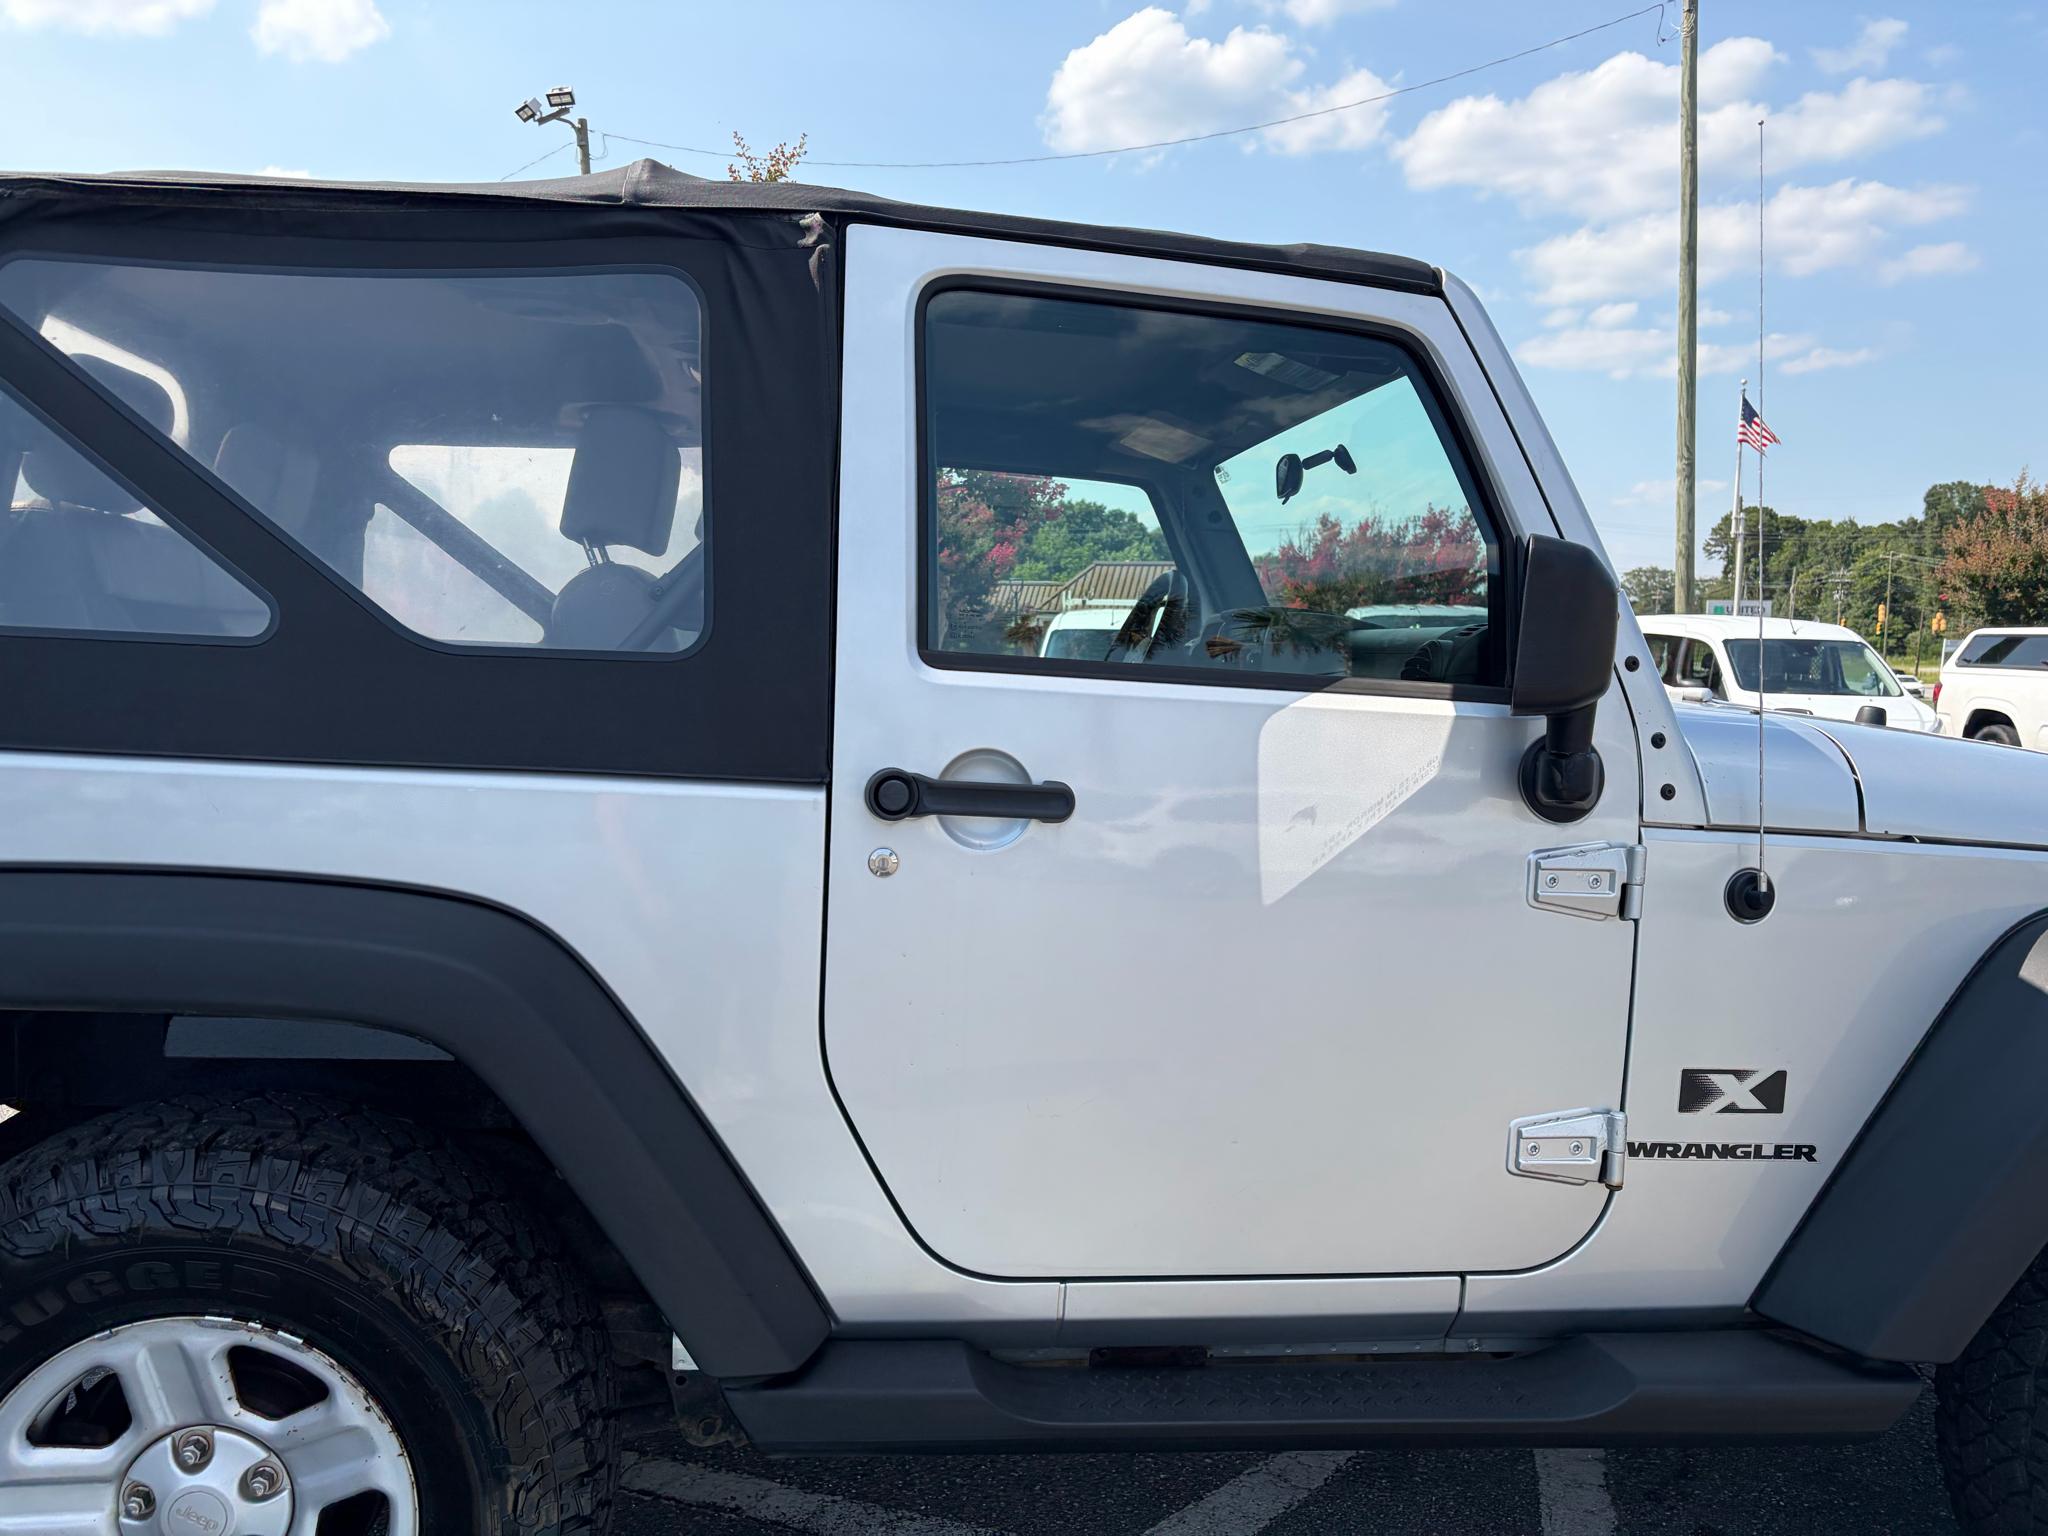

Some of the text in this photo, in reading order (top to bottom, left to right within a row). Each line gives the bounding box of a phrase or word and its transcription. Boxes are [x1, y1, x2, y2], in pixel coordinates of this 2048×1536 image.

[1726, 605, 1766, 616] UITED
[1694, 1069, 1780, 1113] X
[1627, 1142, 1818, 1162] WRANGLER
[175, 1506, 219, 1533] Jeep
